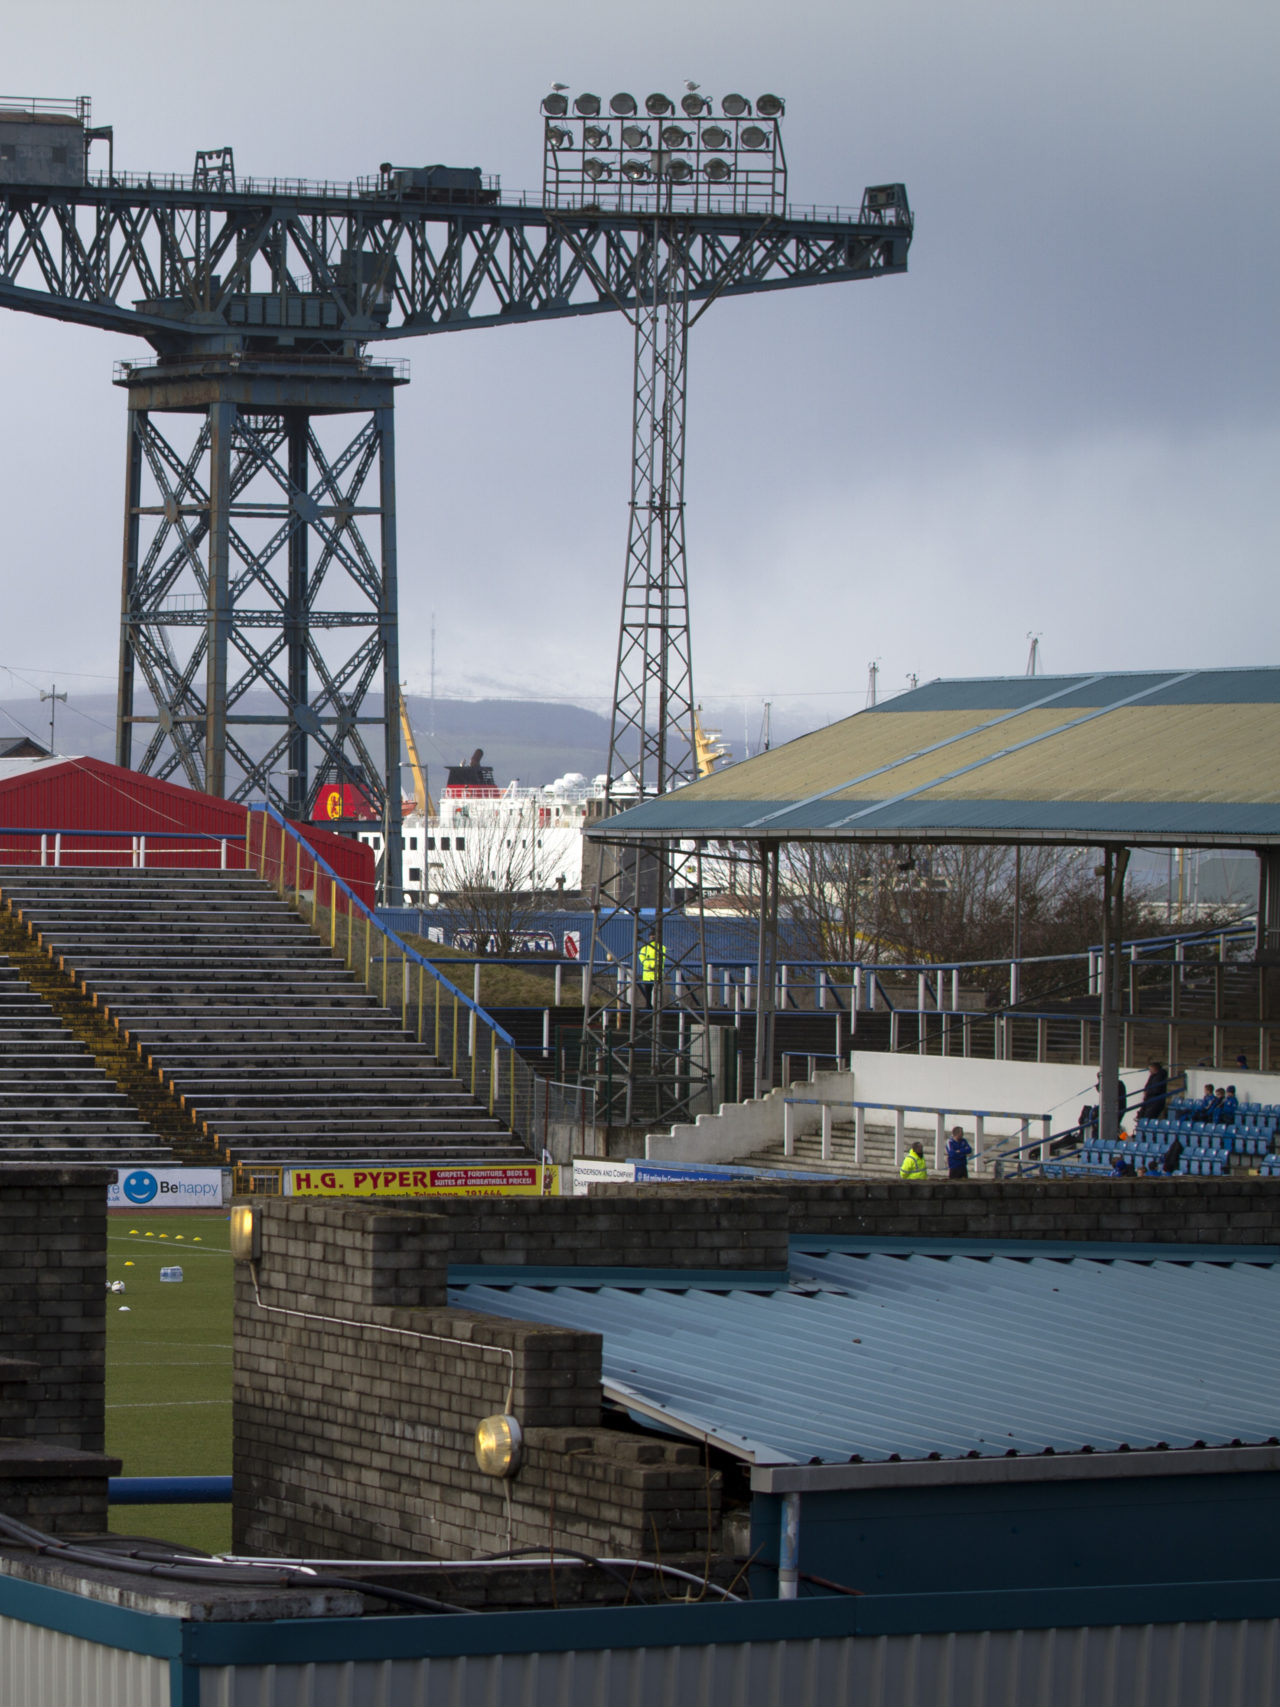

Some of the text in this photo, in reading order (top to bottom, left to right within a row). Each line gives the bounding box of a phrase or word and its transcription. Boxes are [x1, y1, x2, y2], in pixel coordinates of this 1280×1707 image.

[506, 1169, 521, 1177] BEDS
[521, 1169, 529, 1177] &
[296, 1171, 428, 1191] H.G. PYPER
[457, 1178, 466, 1186] AT
